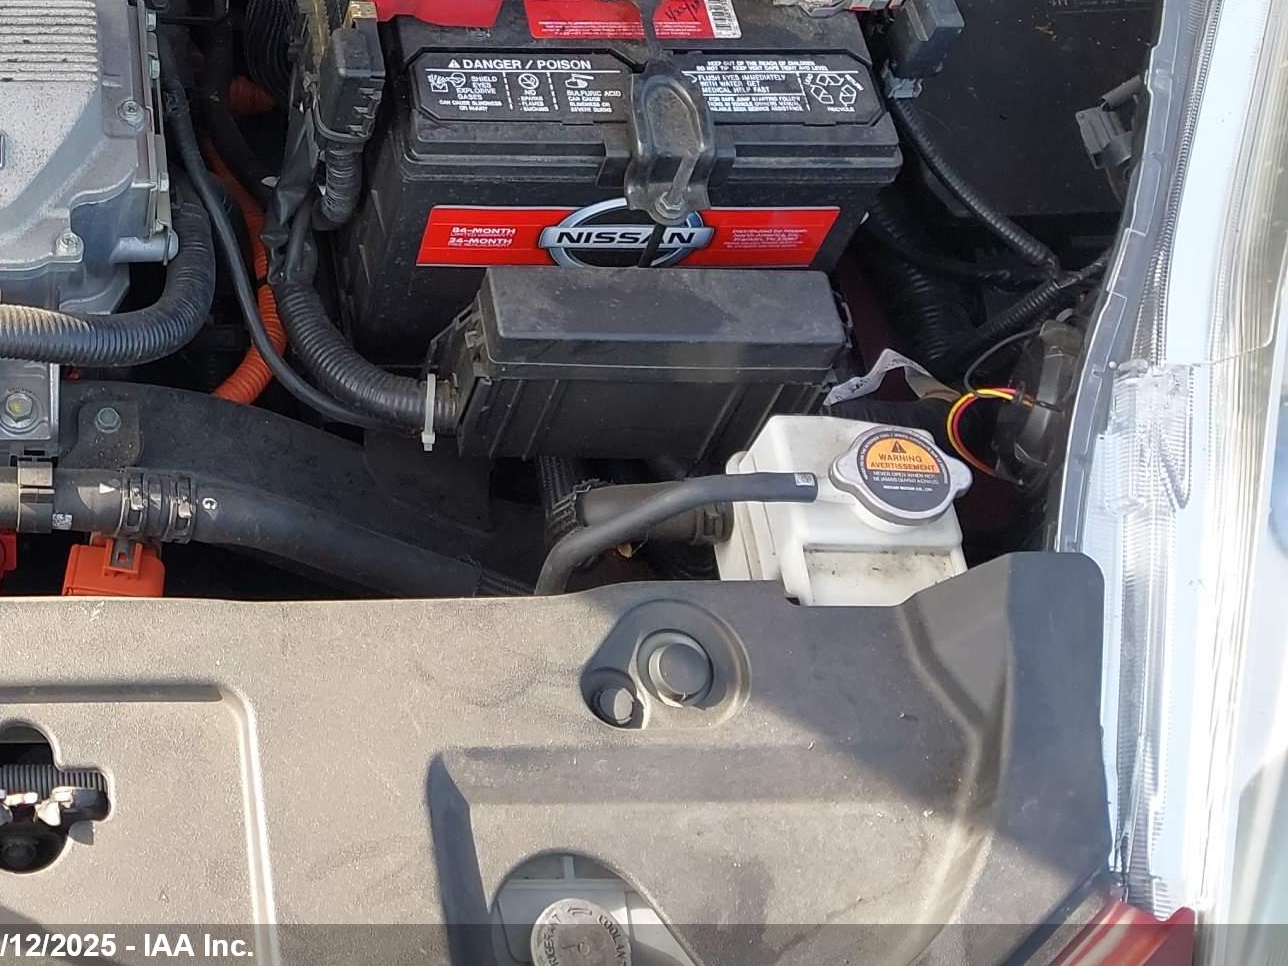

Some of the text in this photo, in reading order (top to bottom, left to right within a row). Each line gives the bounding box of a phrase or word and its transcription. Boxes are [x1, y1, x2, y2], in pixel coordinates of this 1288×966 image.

[462, 60, 592, 69] DANGER / POISON
[556, 230, 696, 245] NISSAN
[878, 454, 923, 463] WARNING
[870, 462, 936, 472] AVERTISSEMENT
